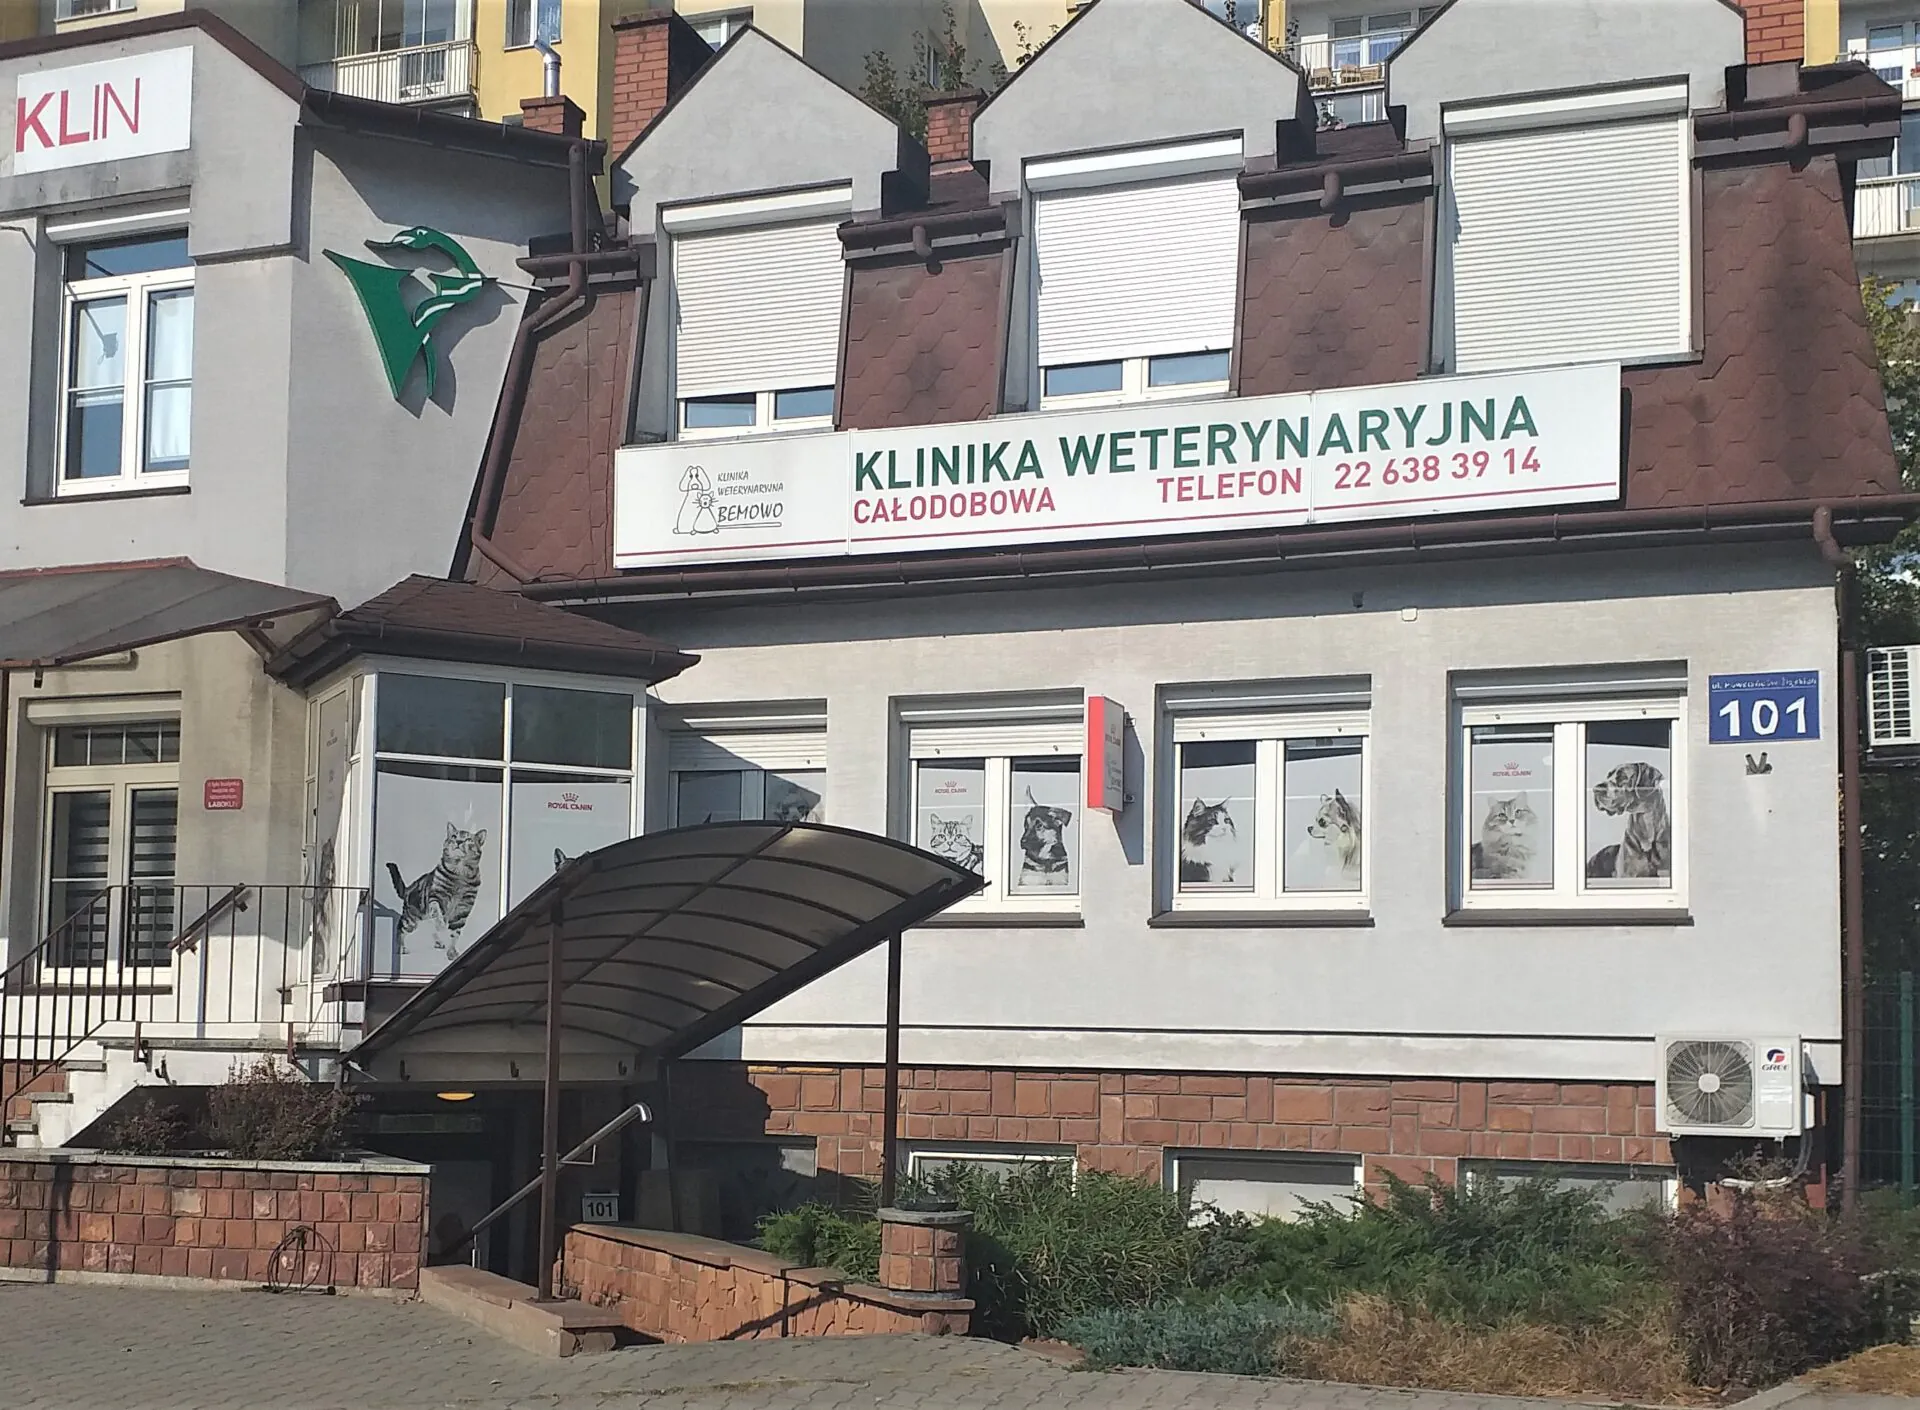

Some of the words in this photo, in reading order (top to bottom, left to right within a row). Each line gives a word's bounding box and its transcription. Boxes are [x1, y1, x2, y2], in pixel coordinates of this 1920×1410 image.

[15, 77, 141, 153] KLIN
[855, 439, 1045, 491] KLINIKA
[1058, 395, 1539, 477] WETERYNARYJNA
[717, 470, 749, 482] KLINIKA
[853, 486, 1056, 524] CAŁODOBOWA
[1156, 467, 1302, 503] TELEFON
[1334, 461, 1371, 489] 22
[1382, 455, 1440, 485] 638
[1451, 451, 1490, 479] 39
[1503, 446, 1541, 474] 14
[717, 502, 784, 523] BEMOWO
[1719, 697, 1806, 737] 101
[547, 801, 569, 810] ROYAL
[570, 803, 593, 811] CANIN
[587, 1202, 613, 1217] 101
